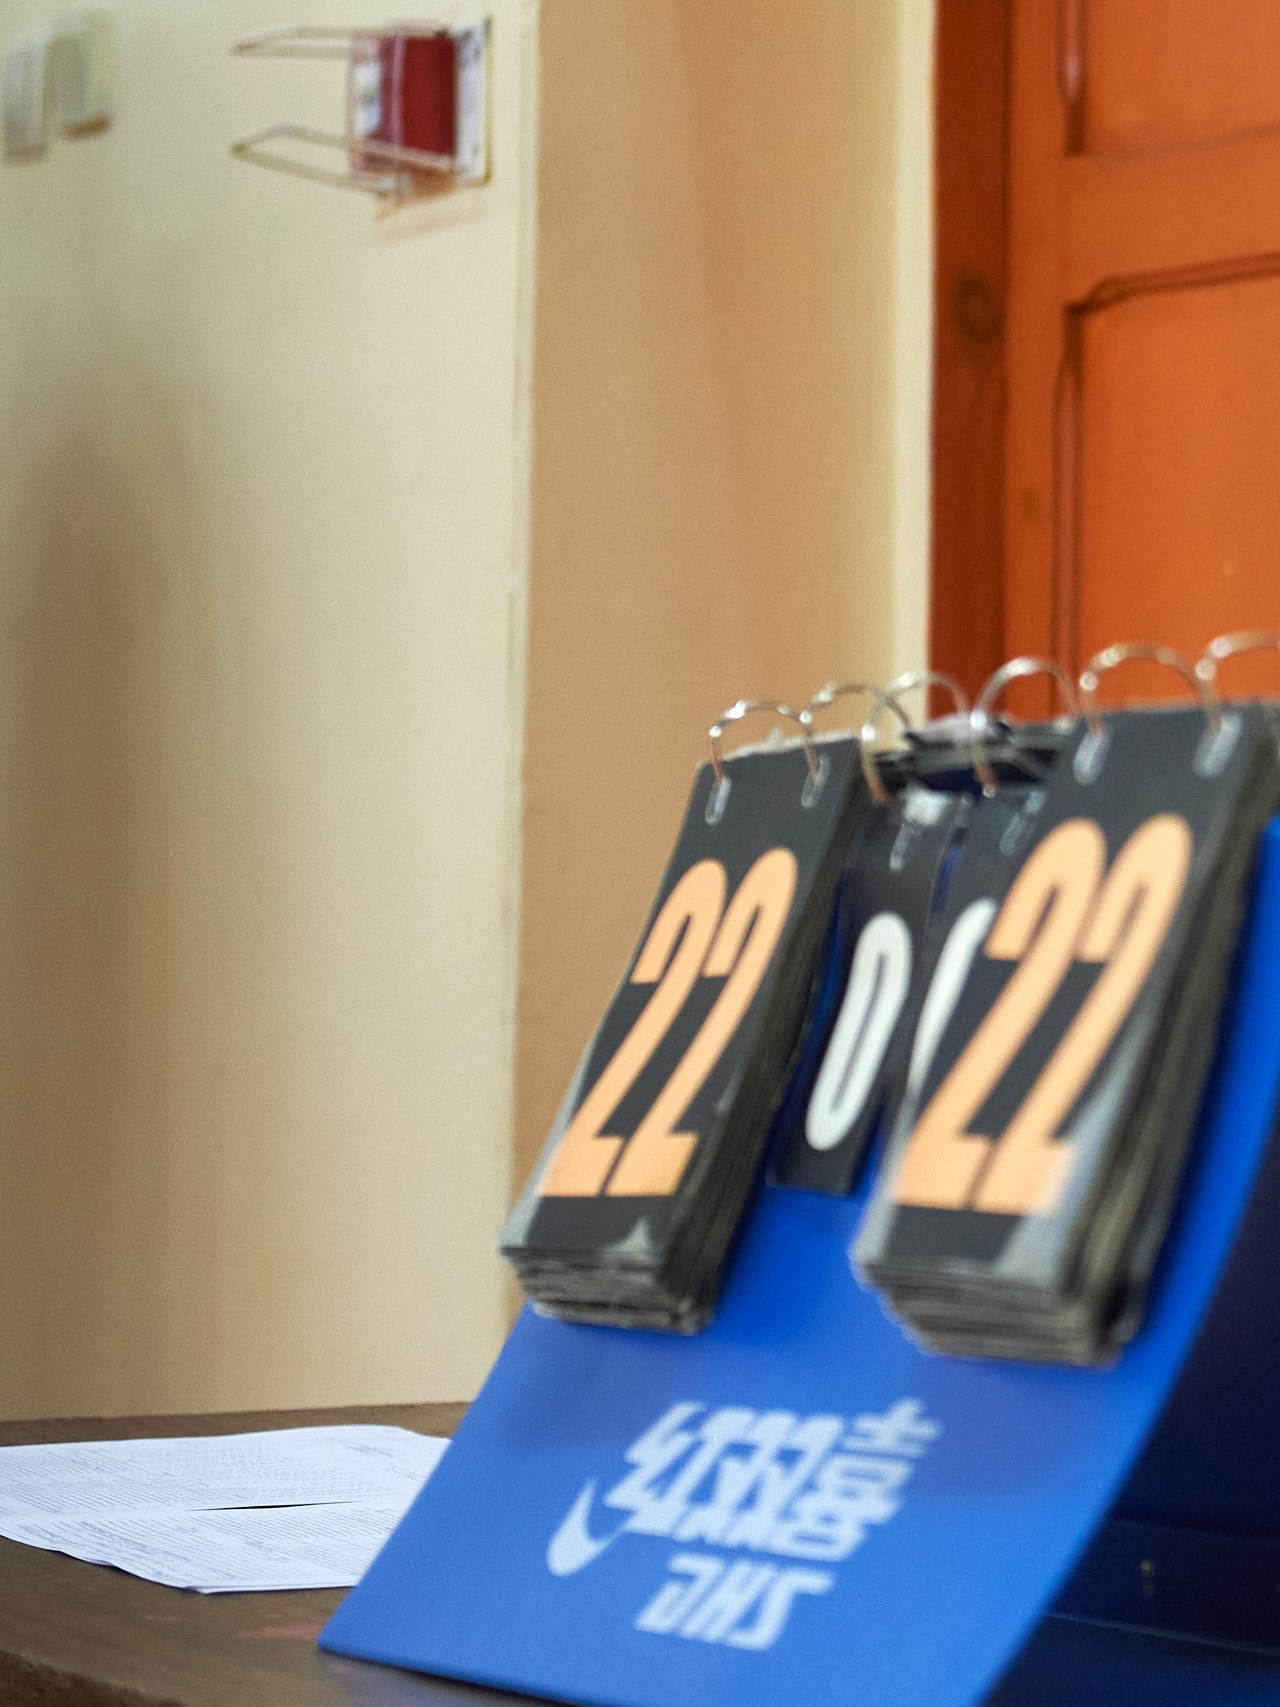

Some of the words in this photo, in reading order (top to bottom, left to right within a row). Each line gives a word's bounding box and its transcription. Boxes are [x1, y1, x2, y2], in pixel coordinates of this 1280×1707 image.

[541, 848, 798, 1197] 22
[805, 911, 913, 1151] 0
[894, 814, 1192, 1217] 22
[634, 1551, 834, 1651] DHS
